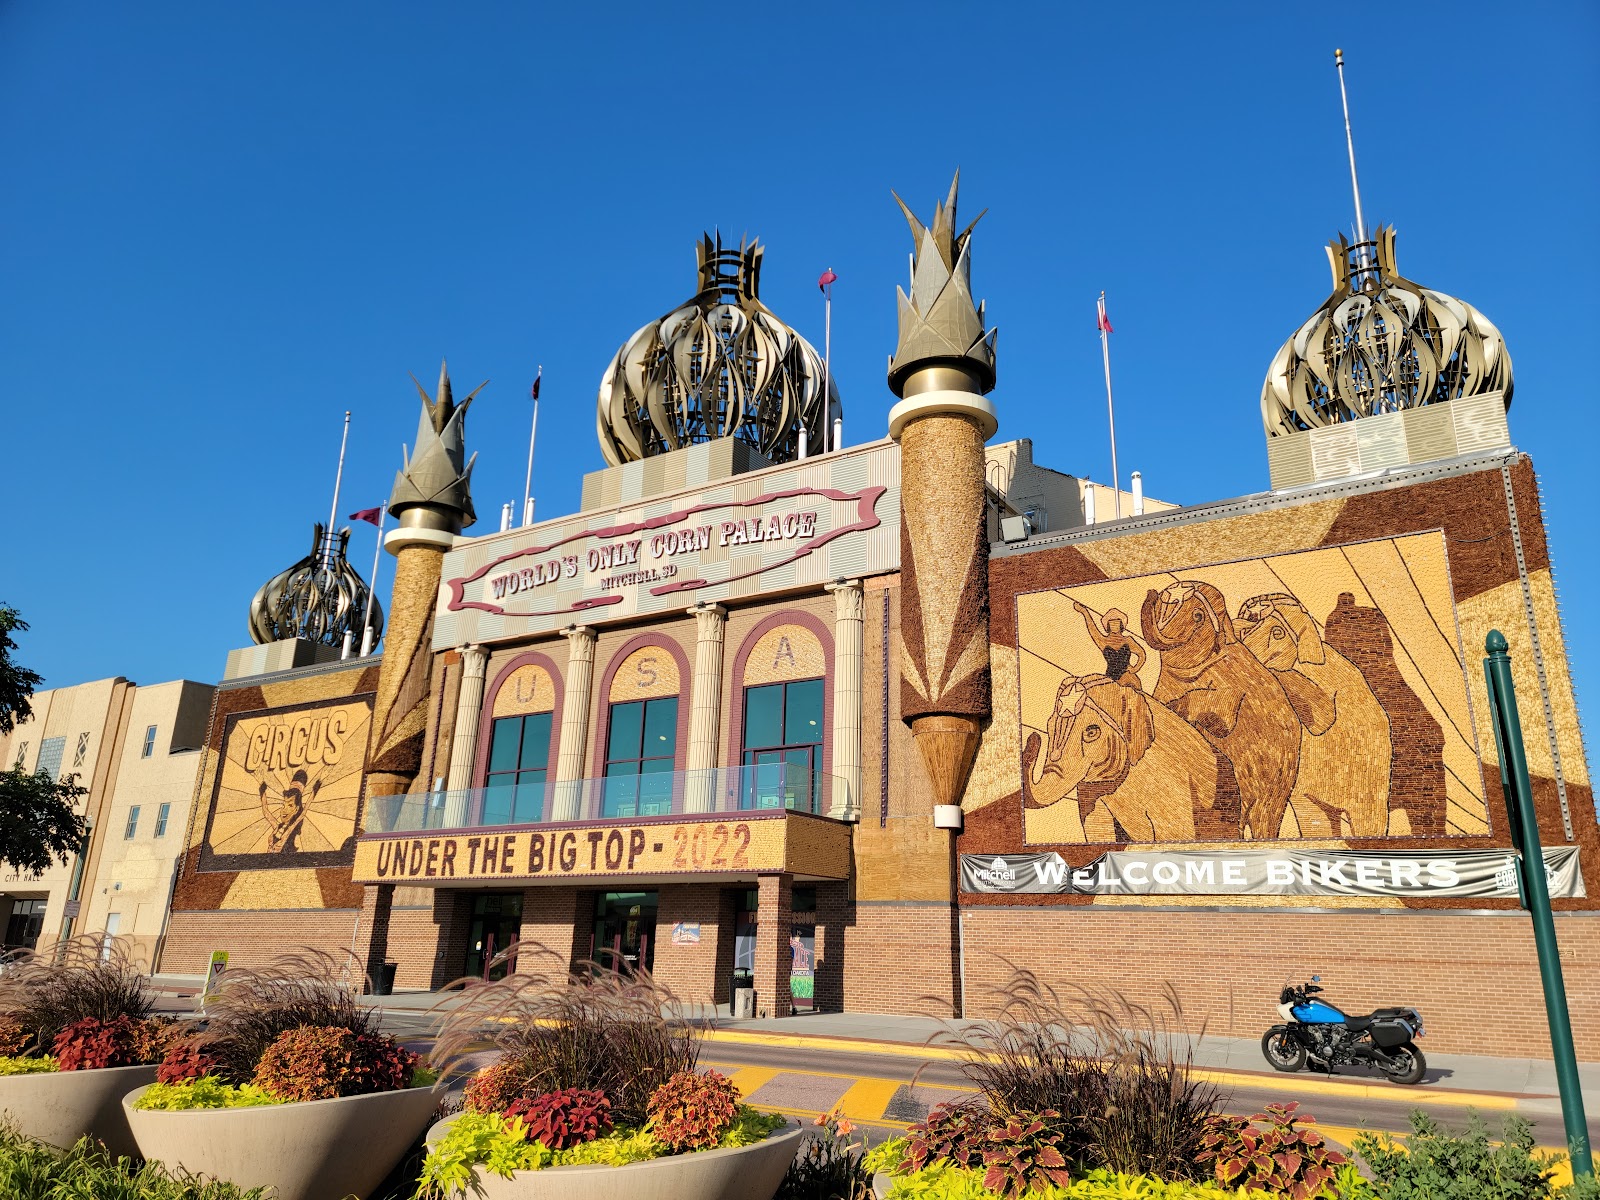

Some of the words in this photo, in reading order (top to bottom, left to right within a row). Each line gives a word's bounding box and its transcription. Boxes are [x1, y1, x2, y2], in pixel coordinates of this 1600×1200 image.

[491, 555, 578, 600] WORLD'S
[586, 539, 641, 573] ONLY
[650, 524, 712, 558] CORN
[719, 512, 817, 546] PALACE
[661, 564, 678, 578] SD
[515, 673, 537, 704] U
[636, 656, 658, 688] S
[772, 635, 796, 670] A
[245, 709, 349, 772] CIRCUS
[377, 839, 457, 877] UNDER
[467, 834, 517, 875] THE
[528, 832, 577, 874] BIG
[587, 828, 646, 871] TOP
[672, 822, 752, 869] 2022
[5, 874, 20, 882] CITY
[973, 868, 1016, 880] Mitchell
[1033, 859, 1248, 886] WELCOME
[1266, 859, 1461, 888] BIKERS
